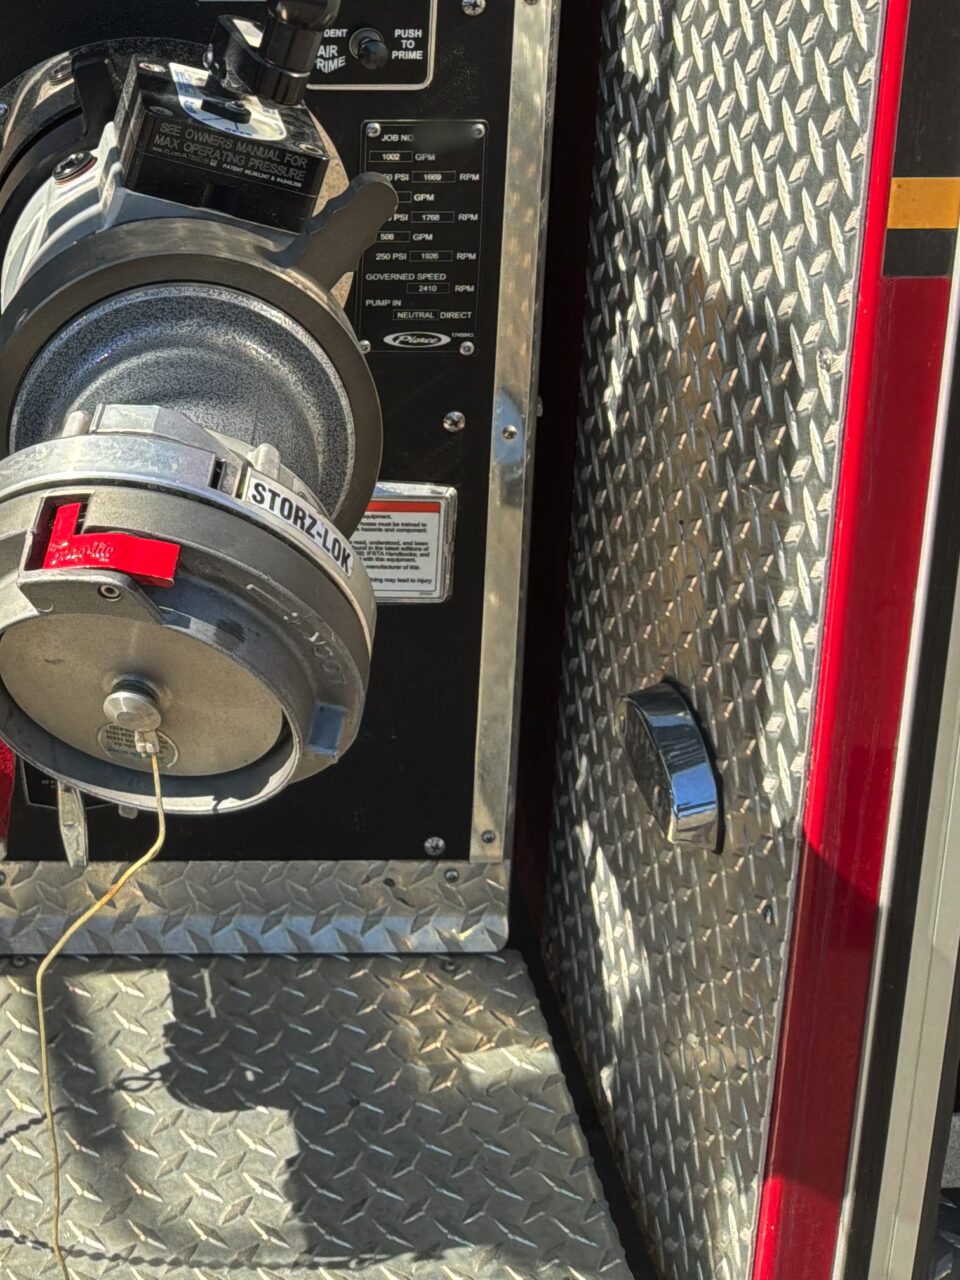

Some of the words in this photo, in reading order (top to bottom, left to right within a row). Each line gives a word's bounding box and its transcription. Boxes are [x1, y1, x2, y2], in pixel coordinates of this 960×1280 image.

[395, 29, 422, 38] PUSH
[401, 40, 415, 48] TO
[318, 45, 338, 56] AIR
[392, 51, 423, 60] PRIME
[160, 122, 182, 137] SEE
[185, 129, 233, 148] OWNERS
[236, 142, 281, 161] MANUAL
[285, 153, 308, 168] FOR
[154, 134, 180, 149] MAX
[184, 142, 245, 166] OPERATING
[248, 159, 305, 181] PRESSURE
[382, 153, 400, 161] 1002
[415, 154, 435, 162] GPM
[460, 174, 480, 182] RPM
[376, 253, 392, 261] 250
[457, 253, 476, 261] RPM
[366, 273, 415, 281] GOVERNED
[417, 273, 446, 281] SPEED
[455, 284, 474, 292] RPM
[366, 299, 391, 307] PUMP
[393, 299, 401, 307] IN
[397, 333, 439, 345] Pierce
[251, 482, 353, 576] STORZ-LOK
